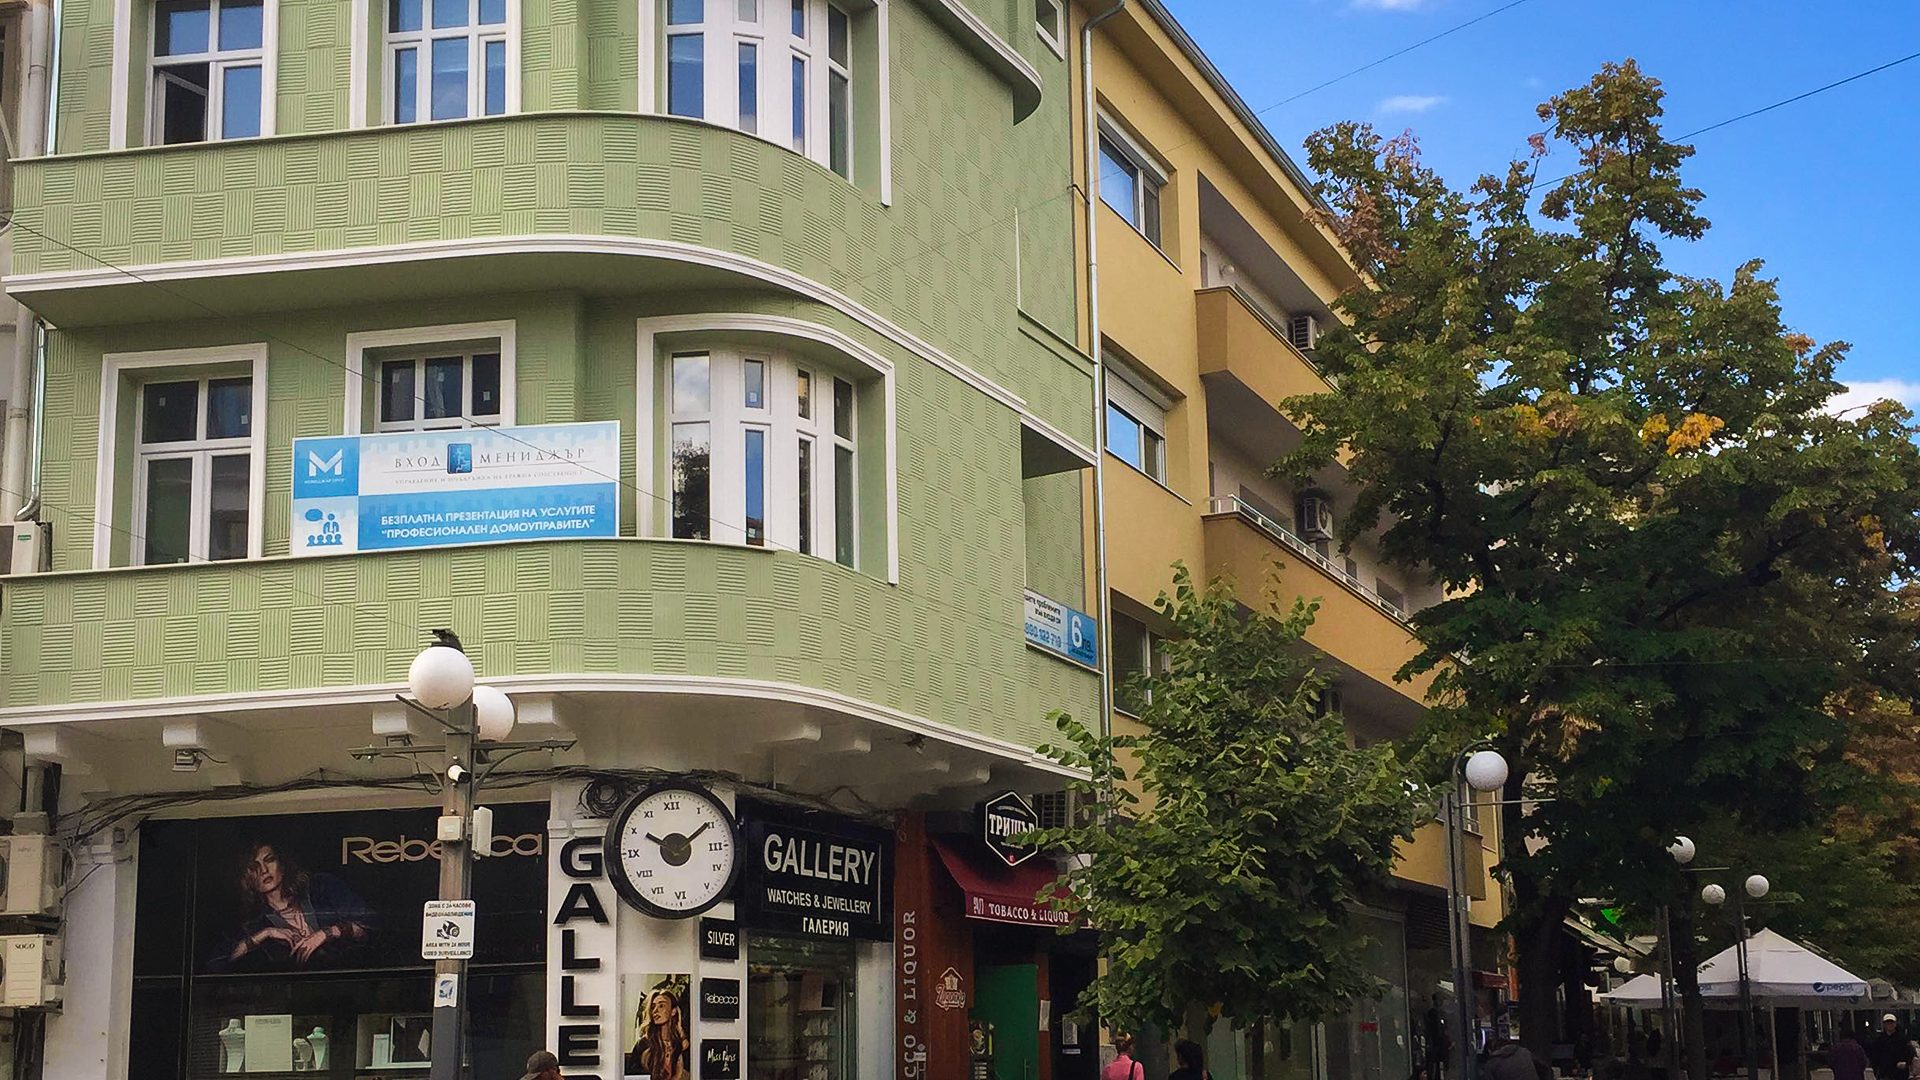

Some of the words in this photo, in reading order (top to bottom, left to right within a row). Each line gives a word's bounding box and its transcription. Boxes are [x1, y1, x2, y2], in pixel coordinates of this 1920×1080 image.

[480, 448, 585, 464] МЕНИДЖЪР
[381, 512, 444, 526] БЕЗПЛАТНА
[445, 510, 520, 522] ПРЕЗЕНТАЦИЯ
[522, 508, 538, 519] НА
[540, 505, 596, 516] УСЛУГИТЕ
[1072, 615, 1082, 648] 6
[664, 802, 680, 810] XII
[628, 849, 640, 858] IX
[708, 842, 723, 852] III
[712, 864, 722, 872] IV
[764, 834, 876, 886] GALLERY
[636, 870, 653, 878] VIII
[651, 886, 664, 894] VII
[704, 882, 710, 890] V
[674, 891, 687, 900] VI
[767, 888, 812, 907] WATCHES
[814, 894, 820, 908] &
[822, 896, 871, 914] JEWELLERY
[988, 903, 1029, 920] TOBACCO
[1030, 908, 1037, 920] &
[1039, 910, 1069, 922] LIQUOR
[802, 917, 849, 937] ГАЛЕРИЯ
[708, 930, 736, 947] SILVER
[553, 837, 609, 1080] GALLE
[904, 910, 917, 1000] LIQUOR
[904, 1010, 917, 1024] &
